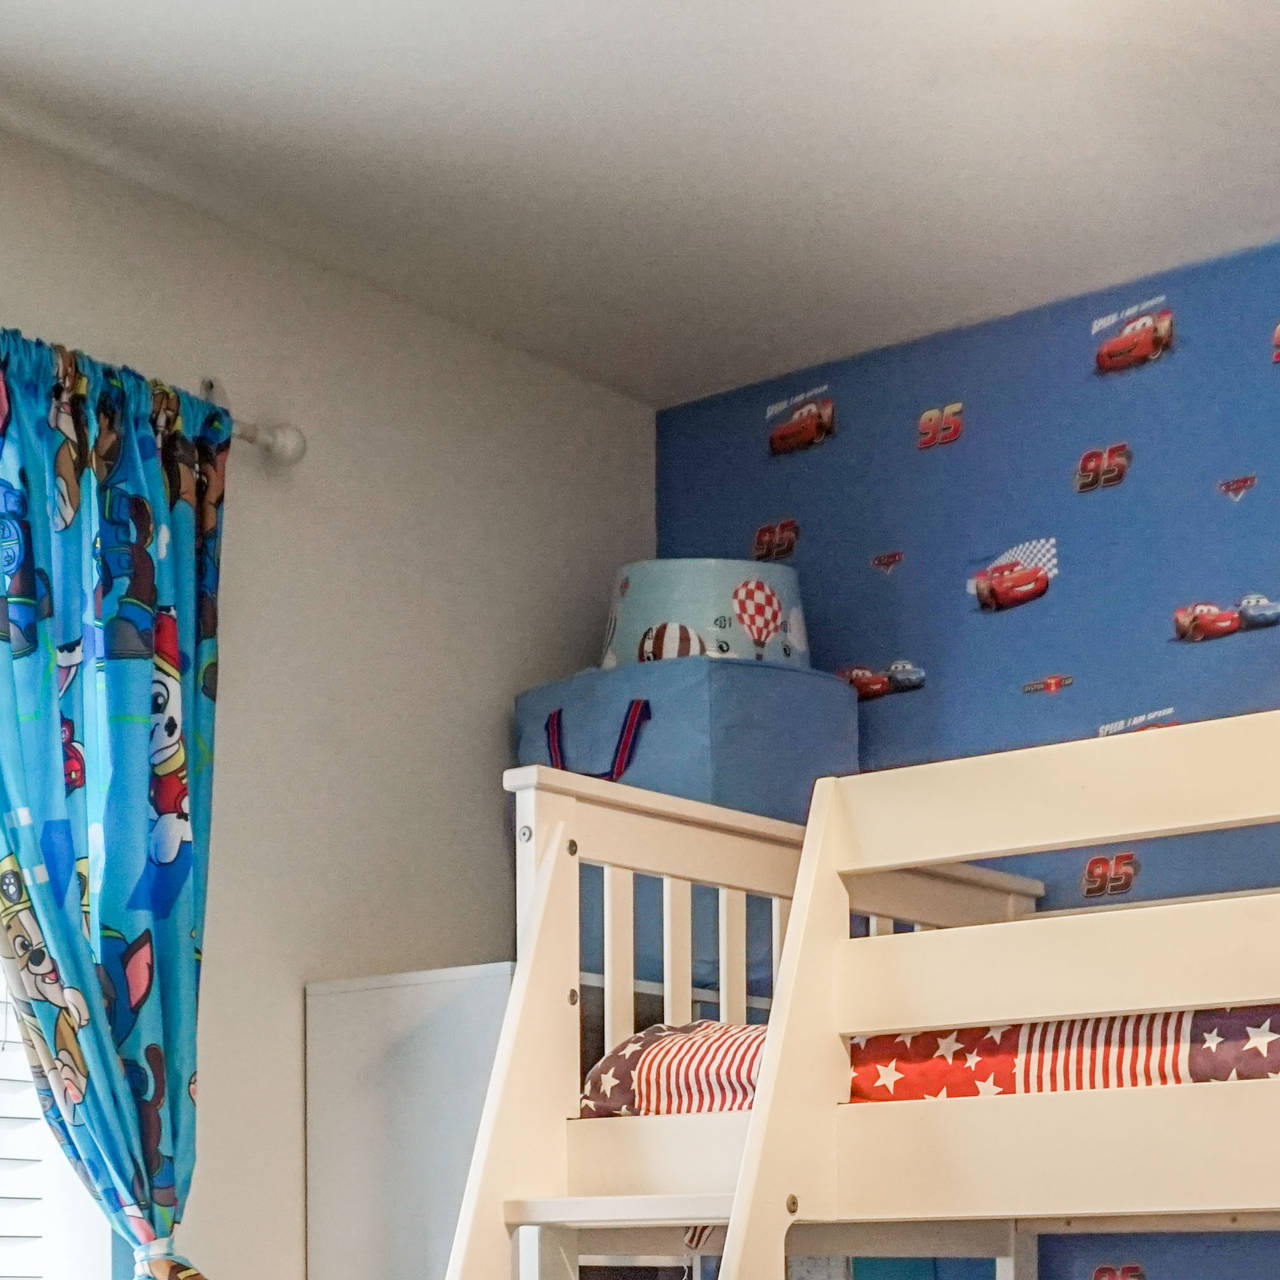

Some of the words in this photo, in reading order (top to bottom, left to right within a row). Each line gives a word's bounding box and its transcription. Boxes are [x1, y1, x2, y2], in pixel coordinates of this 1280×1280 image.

[917, 402, 964, 450] 95
[1077, 442, 1131, 492] 95
[753, 518, 799, 560] 95
[1083, 851, 1137, 897] 95
